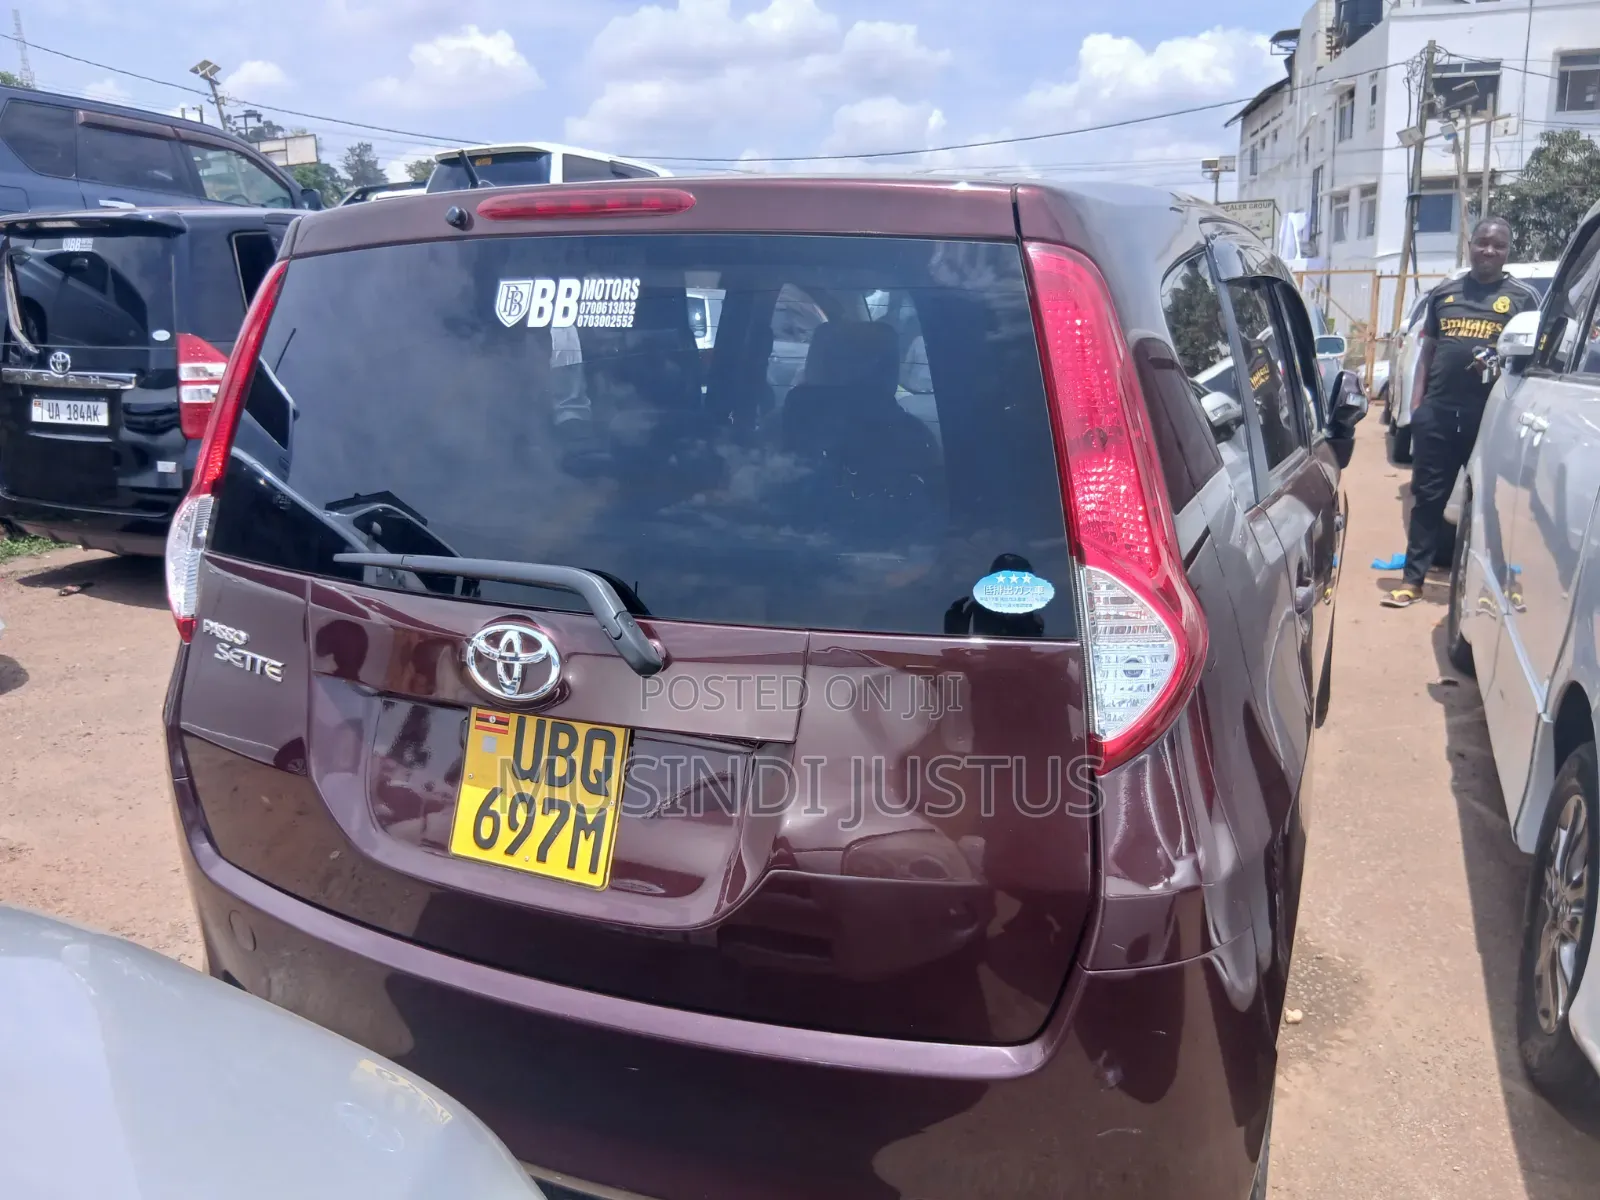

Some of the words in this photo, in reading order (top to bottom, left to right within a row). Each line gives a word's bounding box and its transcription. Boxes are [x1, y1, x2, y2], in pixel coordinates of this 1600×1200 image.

[581, 278, 640, 300] MOTORS
[527, 279, 581, 327] BB
[579, 302, 636, 314] 0700613032
[577, 315, 634, 327] 0703002552
[1440, 317, 1503, 333] Emirates
[48, 402, 60, 420] UA
[67, 404, 100, 422] 184AK
[203, 619, 249, 645] PASSO
[214, 642, 284, 682] SETTE
[512, 716, 616, 797] UBQ
[473, 787, 607, 874] 697M
